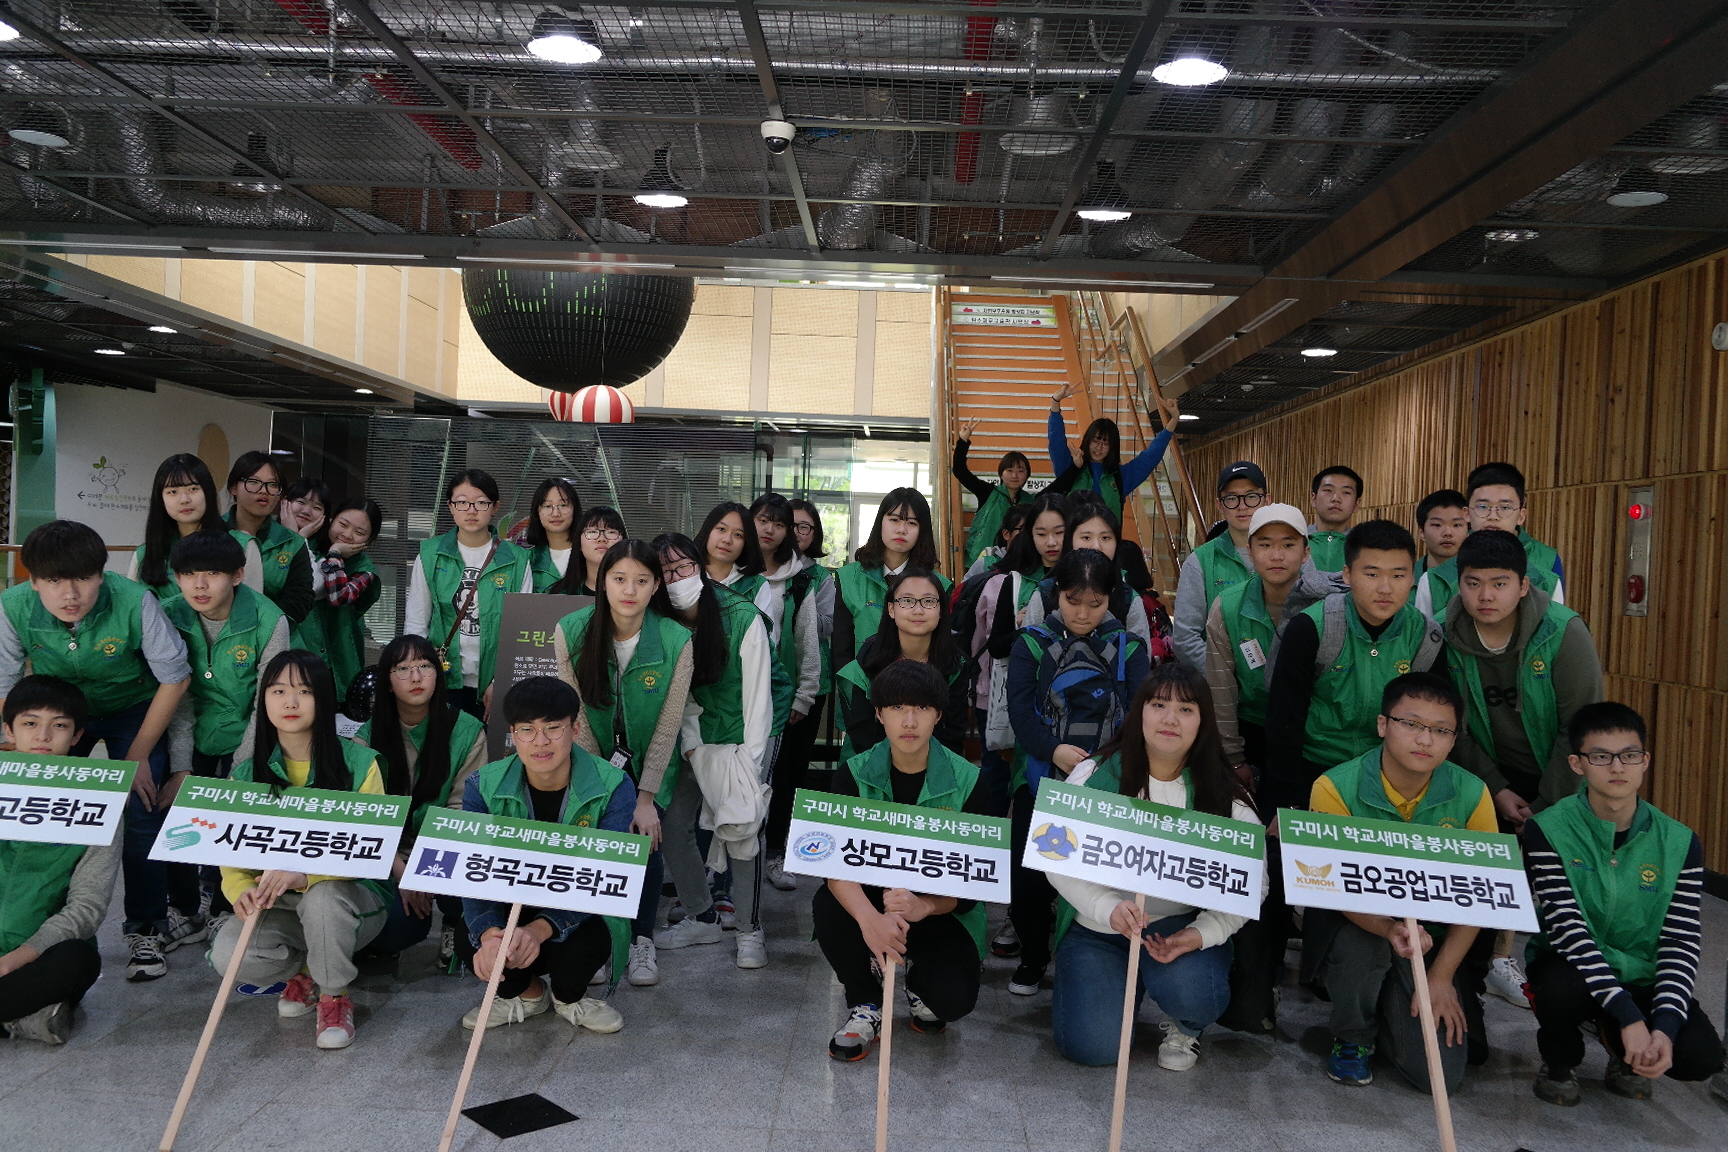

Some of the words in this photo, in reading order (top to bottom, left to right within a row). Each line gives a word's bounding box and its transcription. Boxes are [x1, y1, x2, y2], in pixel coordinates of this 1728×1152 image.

[1027, 480, 1046, 489] 발상지
[0, 796, 108, 827] 고등학교
[187, 786, 236, 805] 구미시
[242, 790, 400, 819] 학교새마을봉사동아리
[802, 799, 847, 819] 구미시
[852, 806, 1002, 840] 학교새마을봉사동아리
[1046, 789, 1093, 814] 구미시
[1097, 802, 1255, 850] 학교새마을봉사동아리
[214, 823, 384, 861] 사곡고등학교
[432, 816, 480, 836] 구미시
[485, 823, 641, 857] 학교새마을봉사동아리
[1288, 819, 1338, 841] 구미시
[1343, 825, 1511, 860] 학교새마을봉사동아리
[464, 853, 629, 898] 형곡고등학교
[840, 838, 999, 883] 상모고등학교
[1081, 834, 1249, 897] 금오여자고등학교
[1296, 876, 1335, 887] KUMOH
[1340, 861, 1520, 910] 금오공업고등학교
